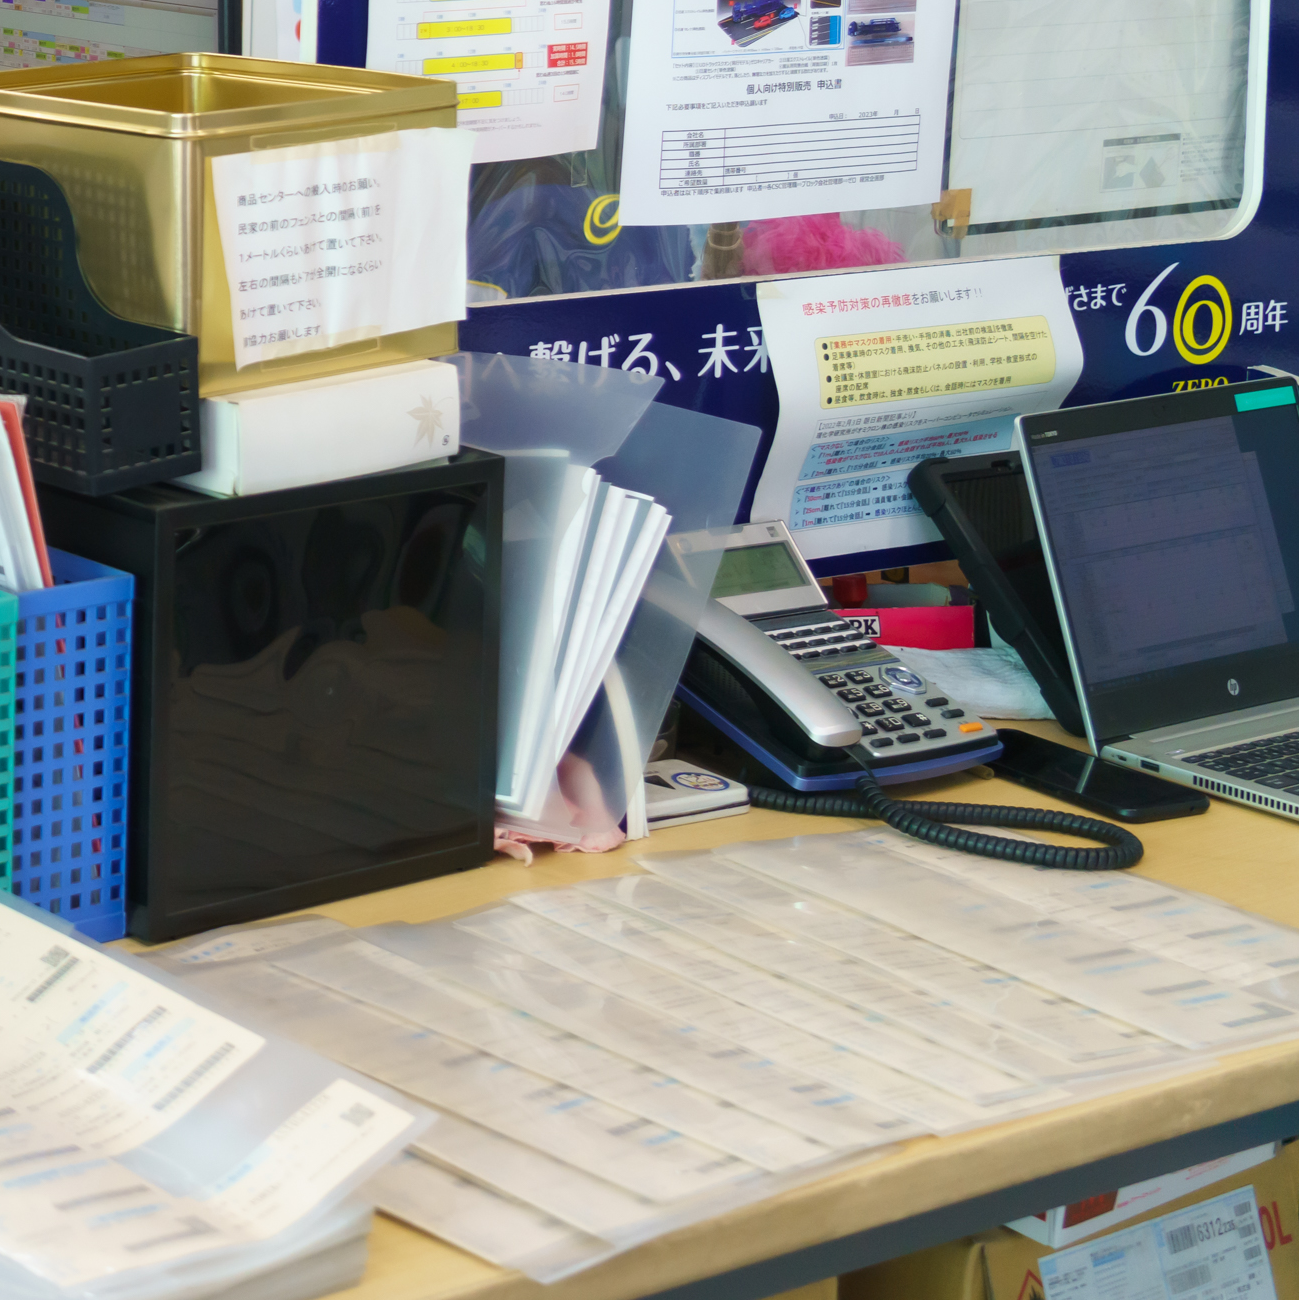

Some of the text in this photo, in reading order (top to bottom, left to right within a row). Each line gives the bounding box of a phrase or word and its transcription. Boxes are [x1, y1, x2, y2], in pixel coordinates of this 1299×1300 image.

[745, 78, 842, 95] 個人向け特別販売 申込書
[836, 669, 872, 683] 2 3
[854, 684, 890, 697] 5 6
[873, 698, 909, 711] 8 9
